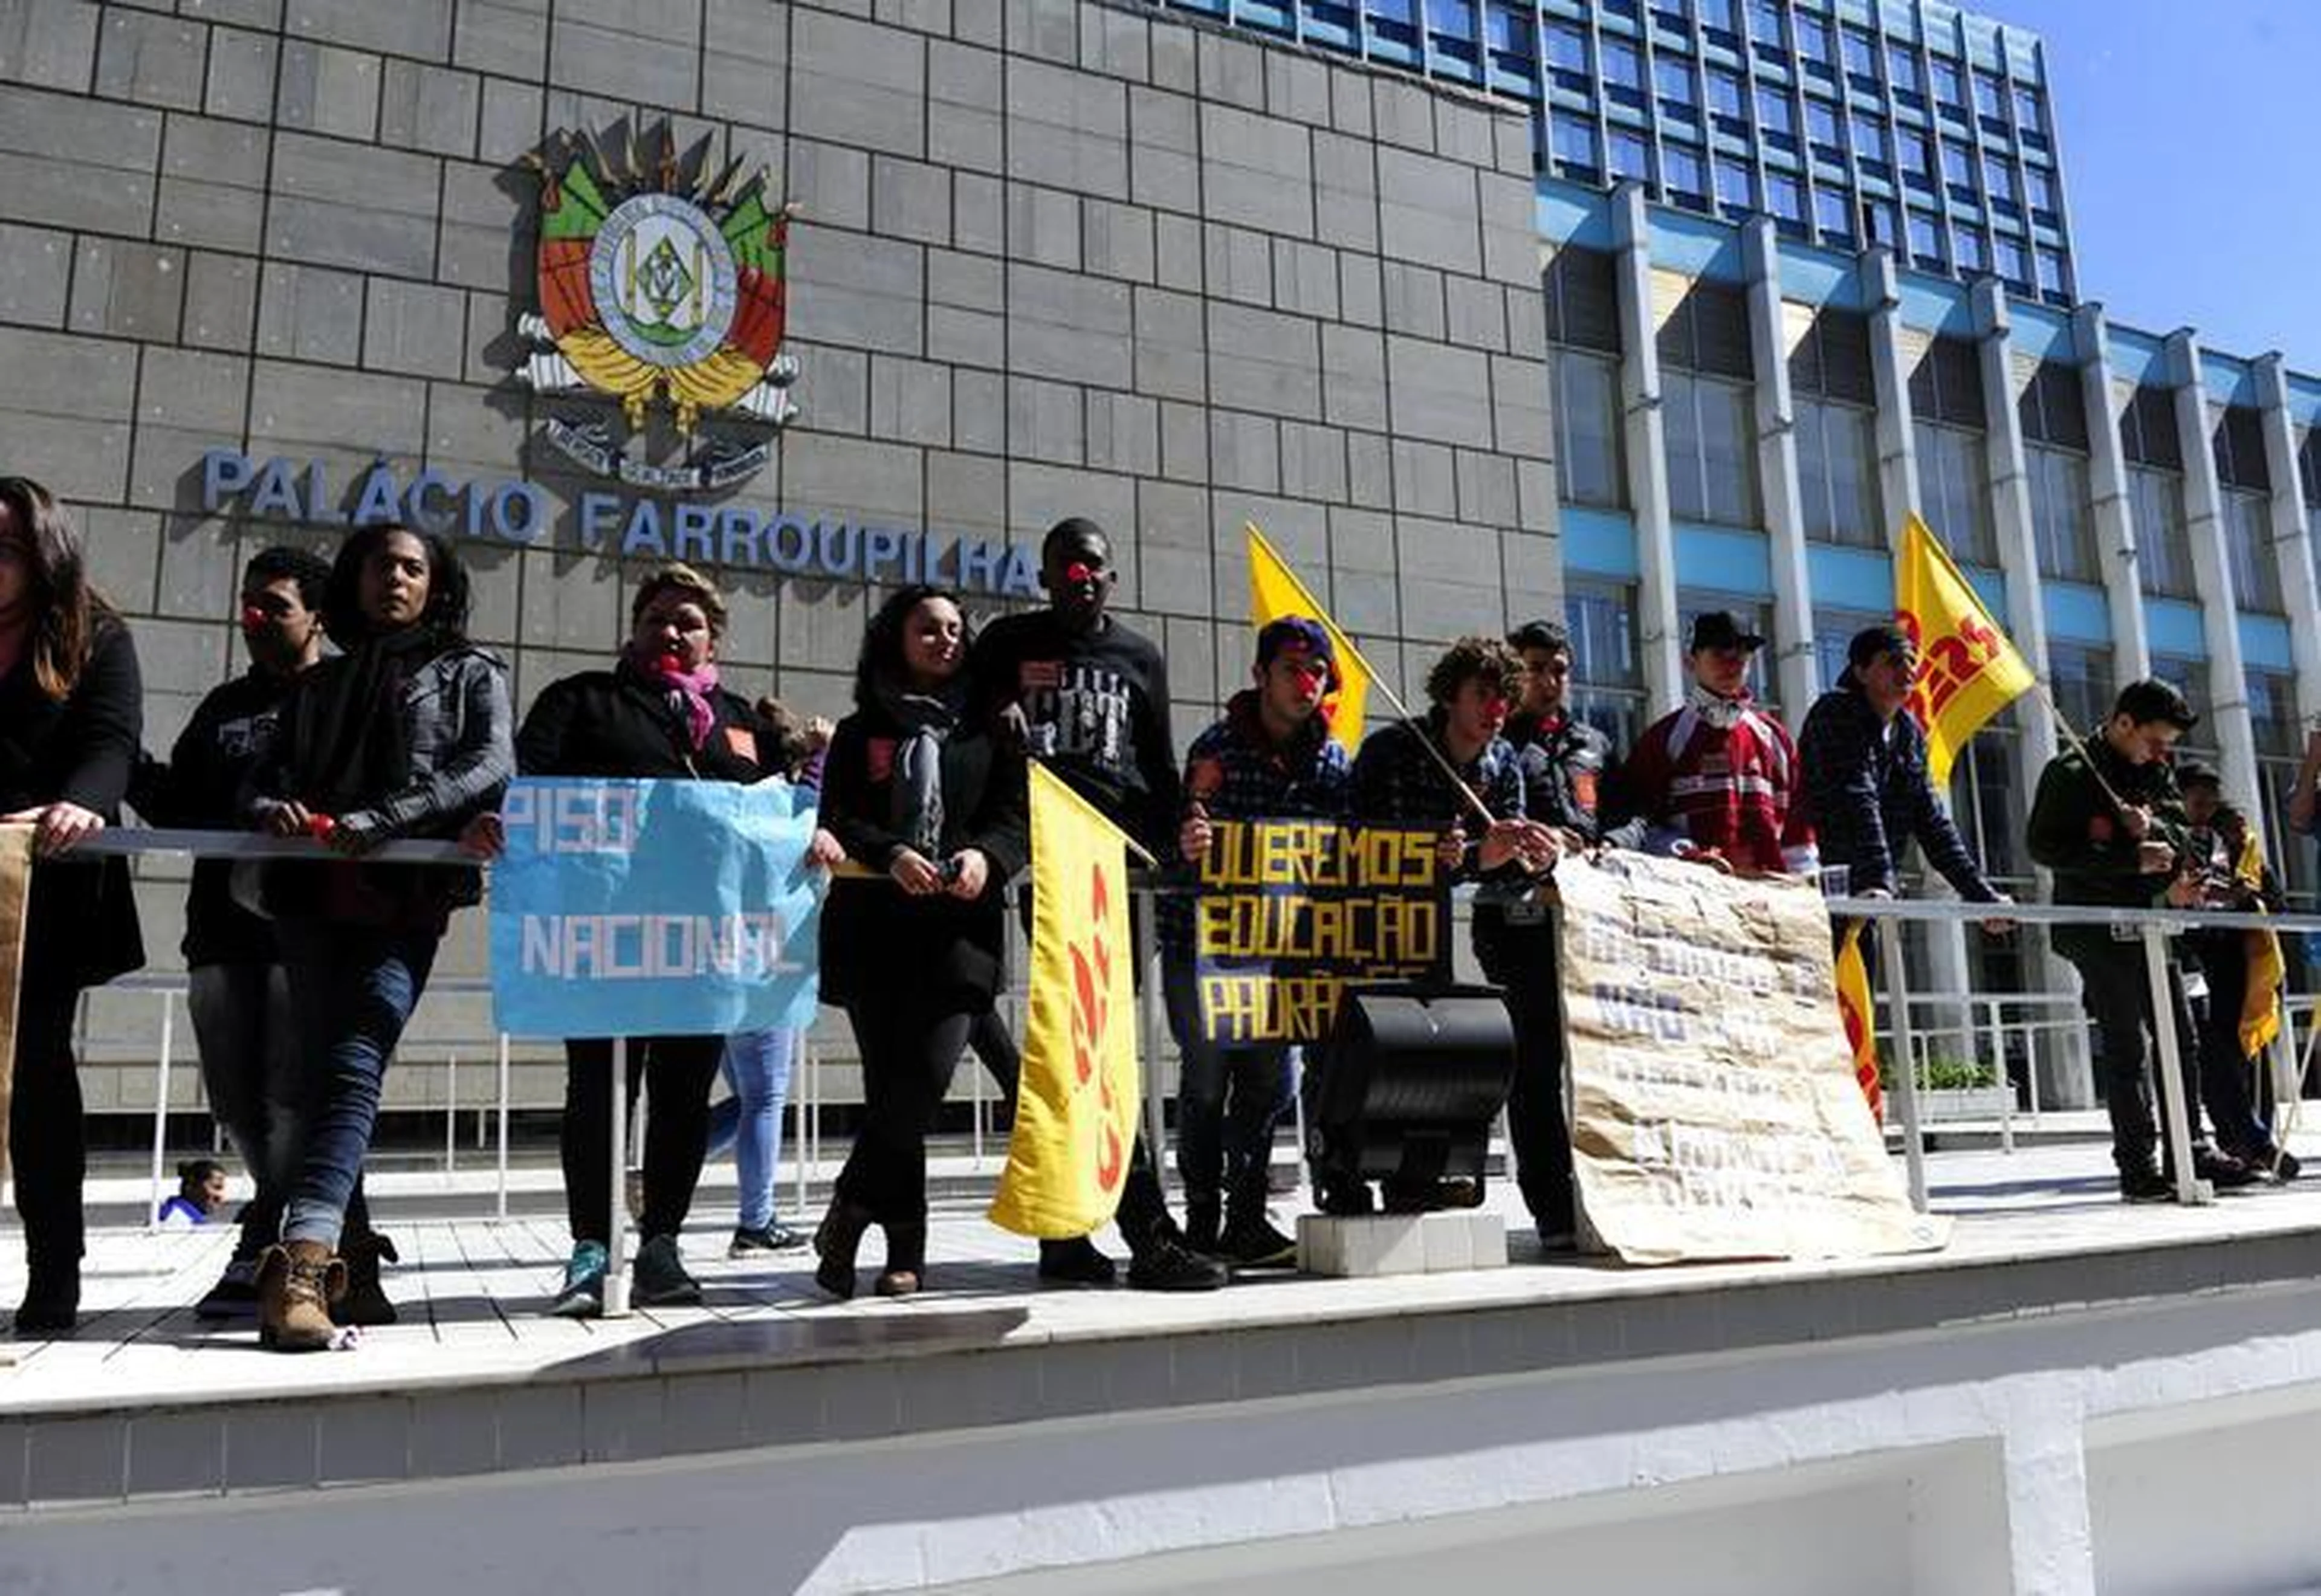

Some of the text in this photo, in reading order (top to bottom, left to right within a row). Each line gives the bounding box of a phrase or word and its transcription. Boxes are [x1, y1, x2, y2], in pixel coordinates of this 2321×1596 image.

[202, 447, 543, 541] PALÁCIO
[581, 492, 1043, 597] FARROUPILHA
[503, 788, 637, 852] PISO
[1200, 821, 1437, 889] QUEREMOS
[522, 913, 804, 980] NACIONAL
[1200, 894, 1437, 966] EDUCAÇÃO
